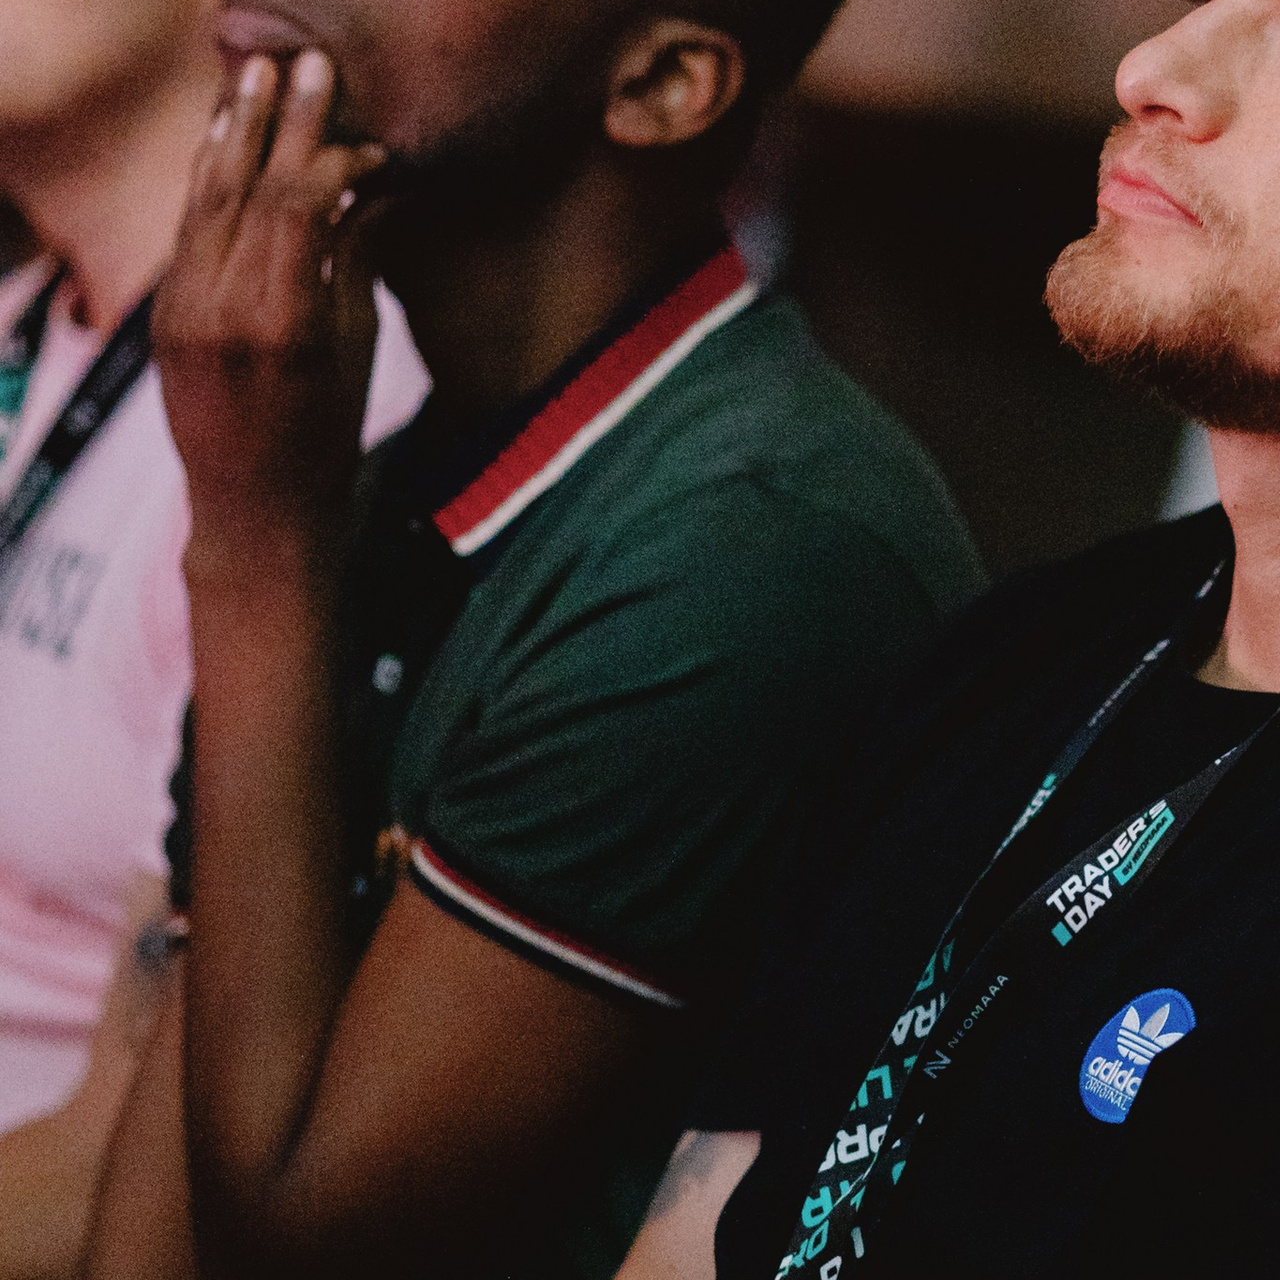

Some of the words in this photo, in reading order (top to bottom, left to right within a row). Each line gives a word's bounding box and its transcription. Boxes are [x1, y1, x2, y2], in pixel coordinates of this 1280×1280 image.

[1046, 799, 1167, 913] TRADER'S
[1064, 875, 1112, 933] DAY
[948, 975, 1009, 1049] NEOMAAA
[849, 1065, 892, 1112] LI
